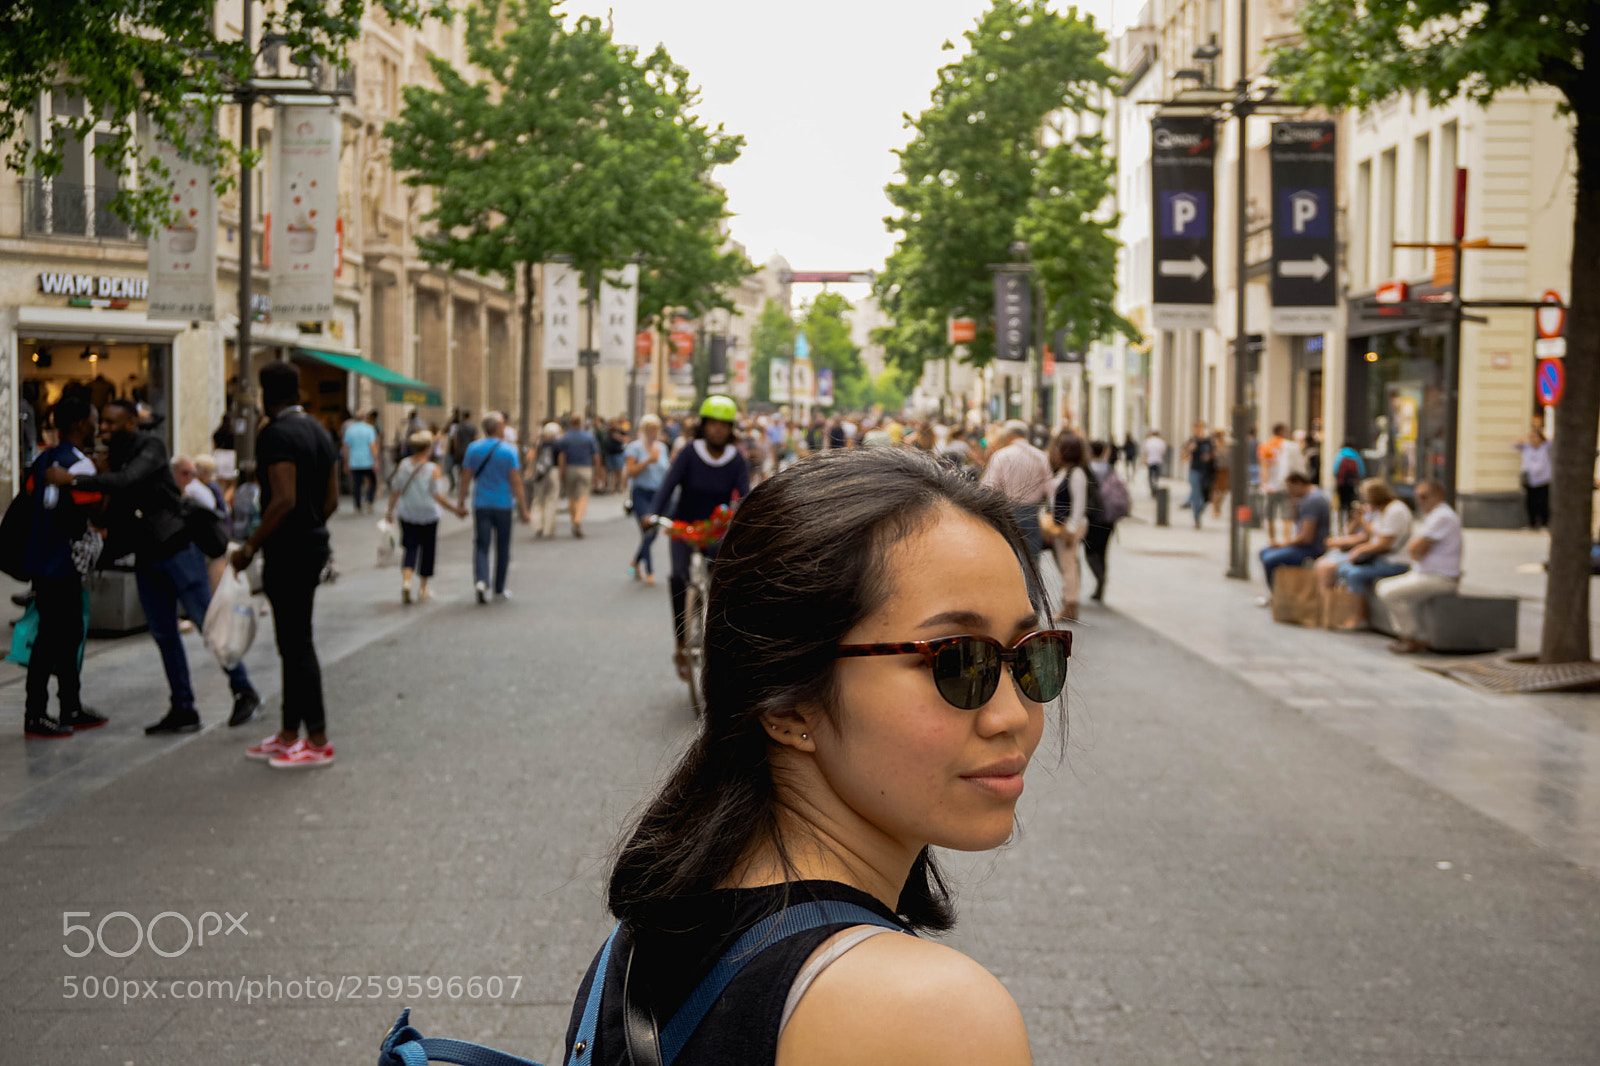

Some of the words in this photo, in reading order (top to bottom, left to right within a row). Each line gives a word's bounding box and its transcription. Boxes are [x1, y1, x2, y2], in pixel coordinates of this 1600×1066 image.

[1172, 199, 1197, 234] P
[1292, 198, 1318, 234] P
[41, 273, 93, 295] WAM
